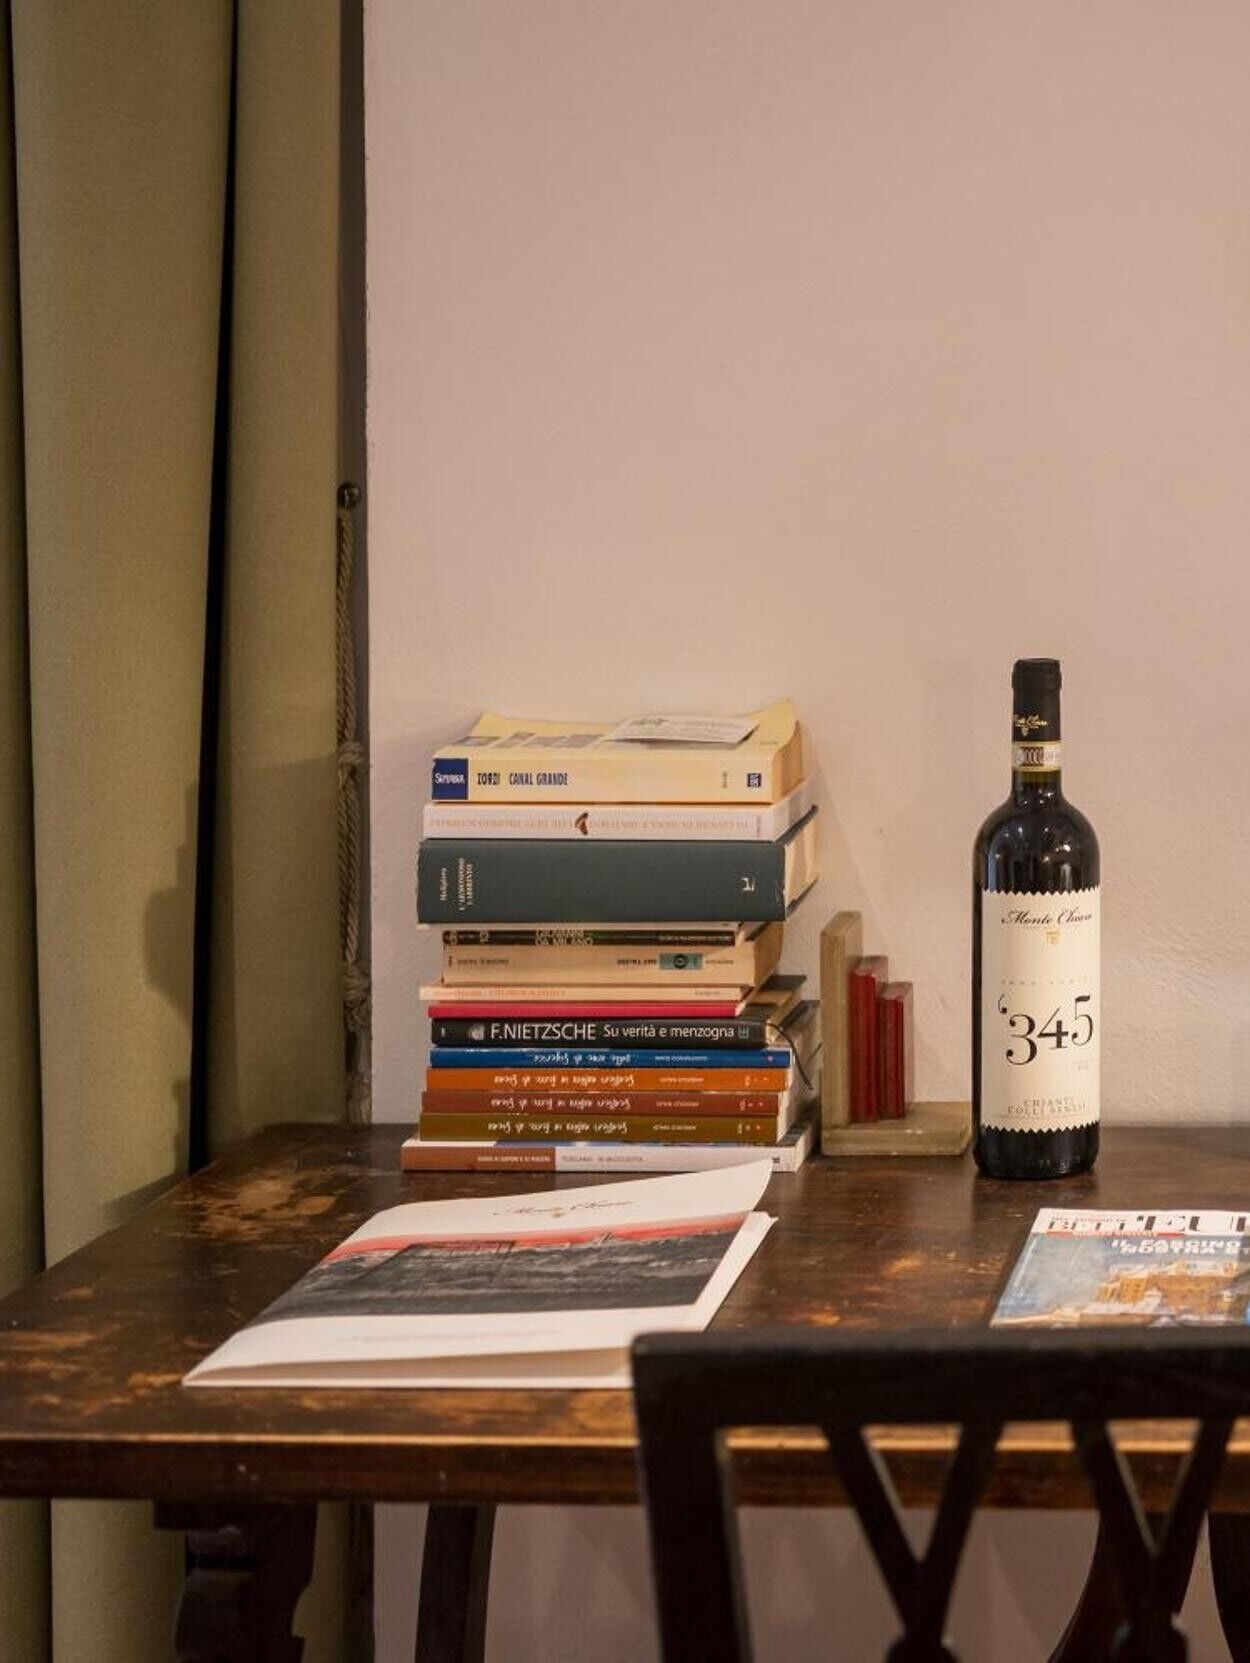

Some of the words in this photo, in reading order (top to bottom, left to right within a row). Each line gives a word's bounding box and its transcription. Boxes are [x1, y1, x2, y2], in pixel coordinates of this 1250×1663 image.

[509, 773, 533, 785] CANAL
[537, 773, 568, 785] GRANDE
[491, 1023, 596, 1040] F.NIETZSCHE
[604, 1024, 619, 1038] Su
[623, 1023, 656, 1038] verità
[659, 1027, 667, 1038] e
[671, 1026, 734, 1040] menzogna
